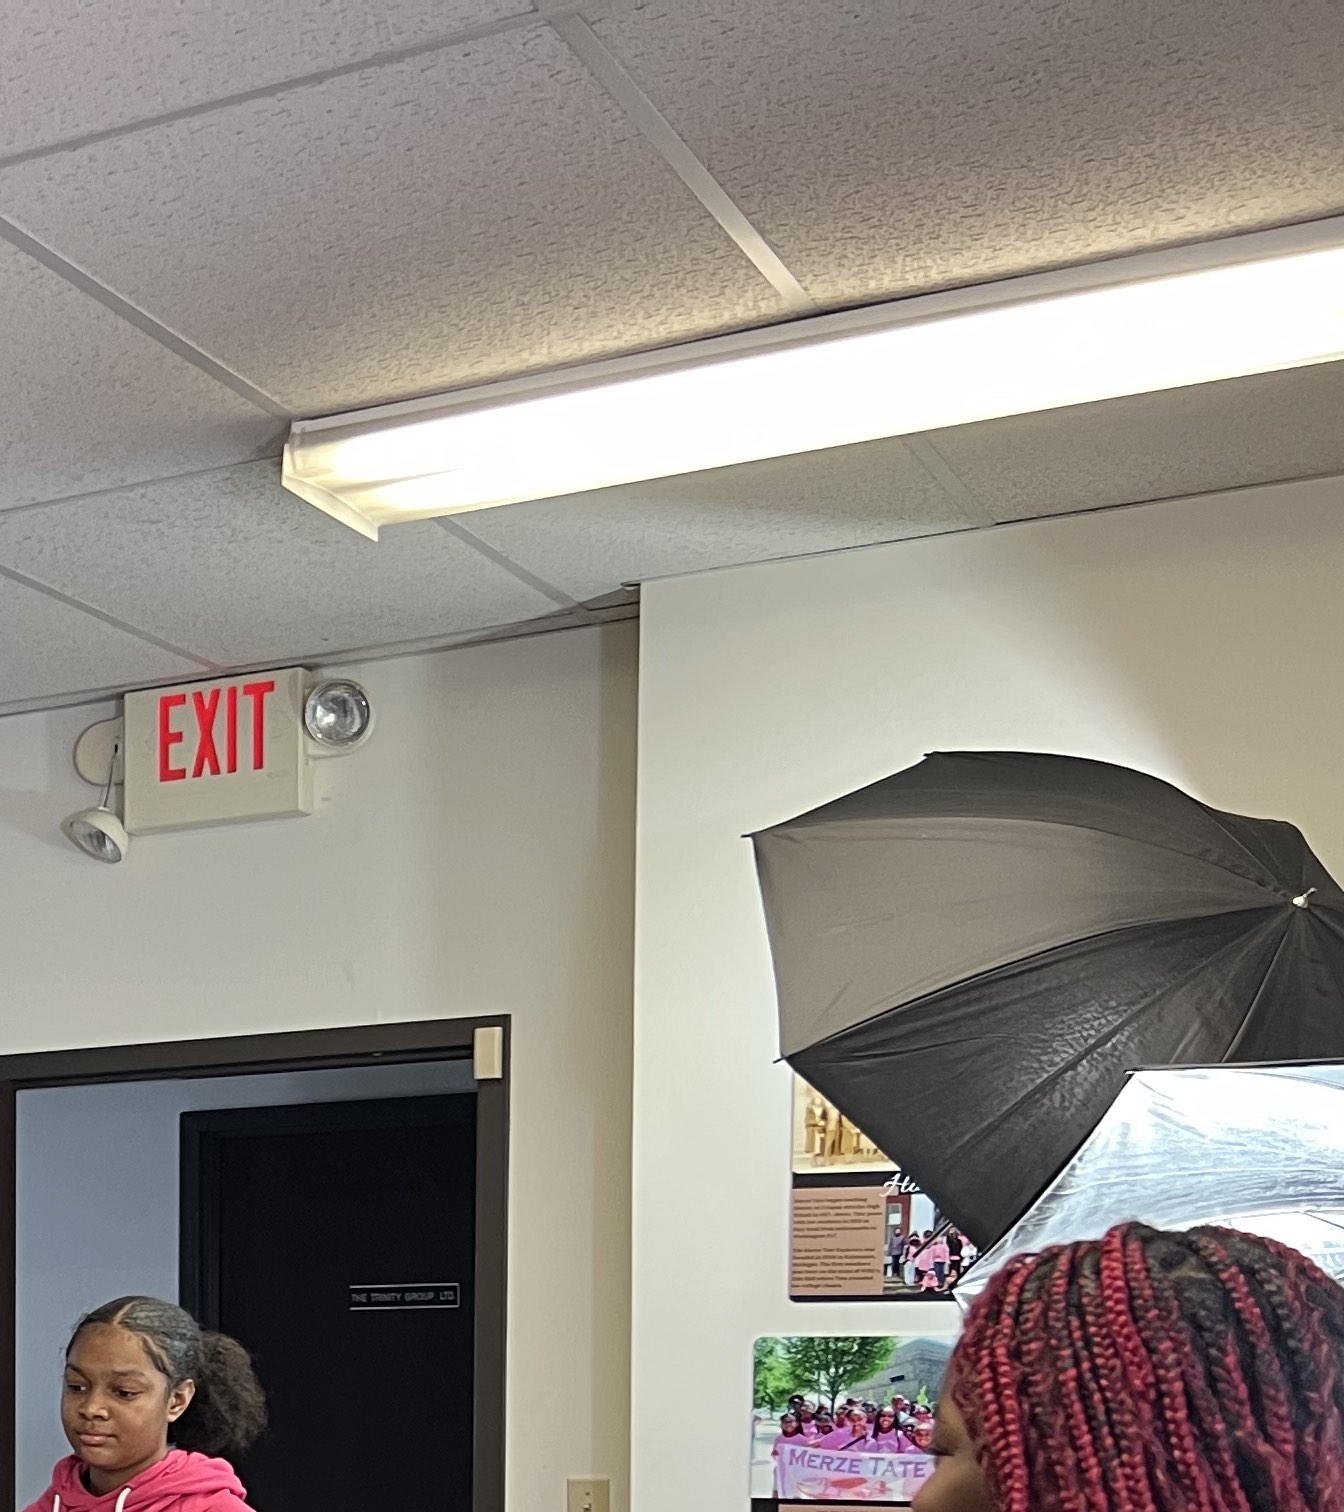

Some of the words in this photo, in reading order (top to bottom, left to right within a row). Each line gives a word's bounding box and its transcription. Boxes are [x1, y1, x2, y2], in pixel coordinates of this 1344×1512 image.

[159, 681, 275, 782] EXIT
[352, 1293, 367, 1302] THE
[371, 1293, 401, 1301] TRINITY
[789, 1449, 861, 1474] MERZE
[869, 1457, 927, 1478] TATE
